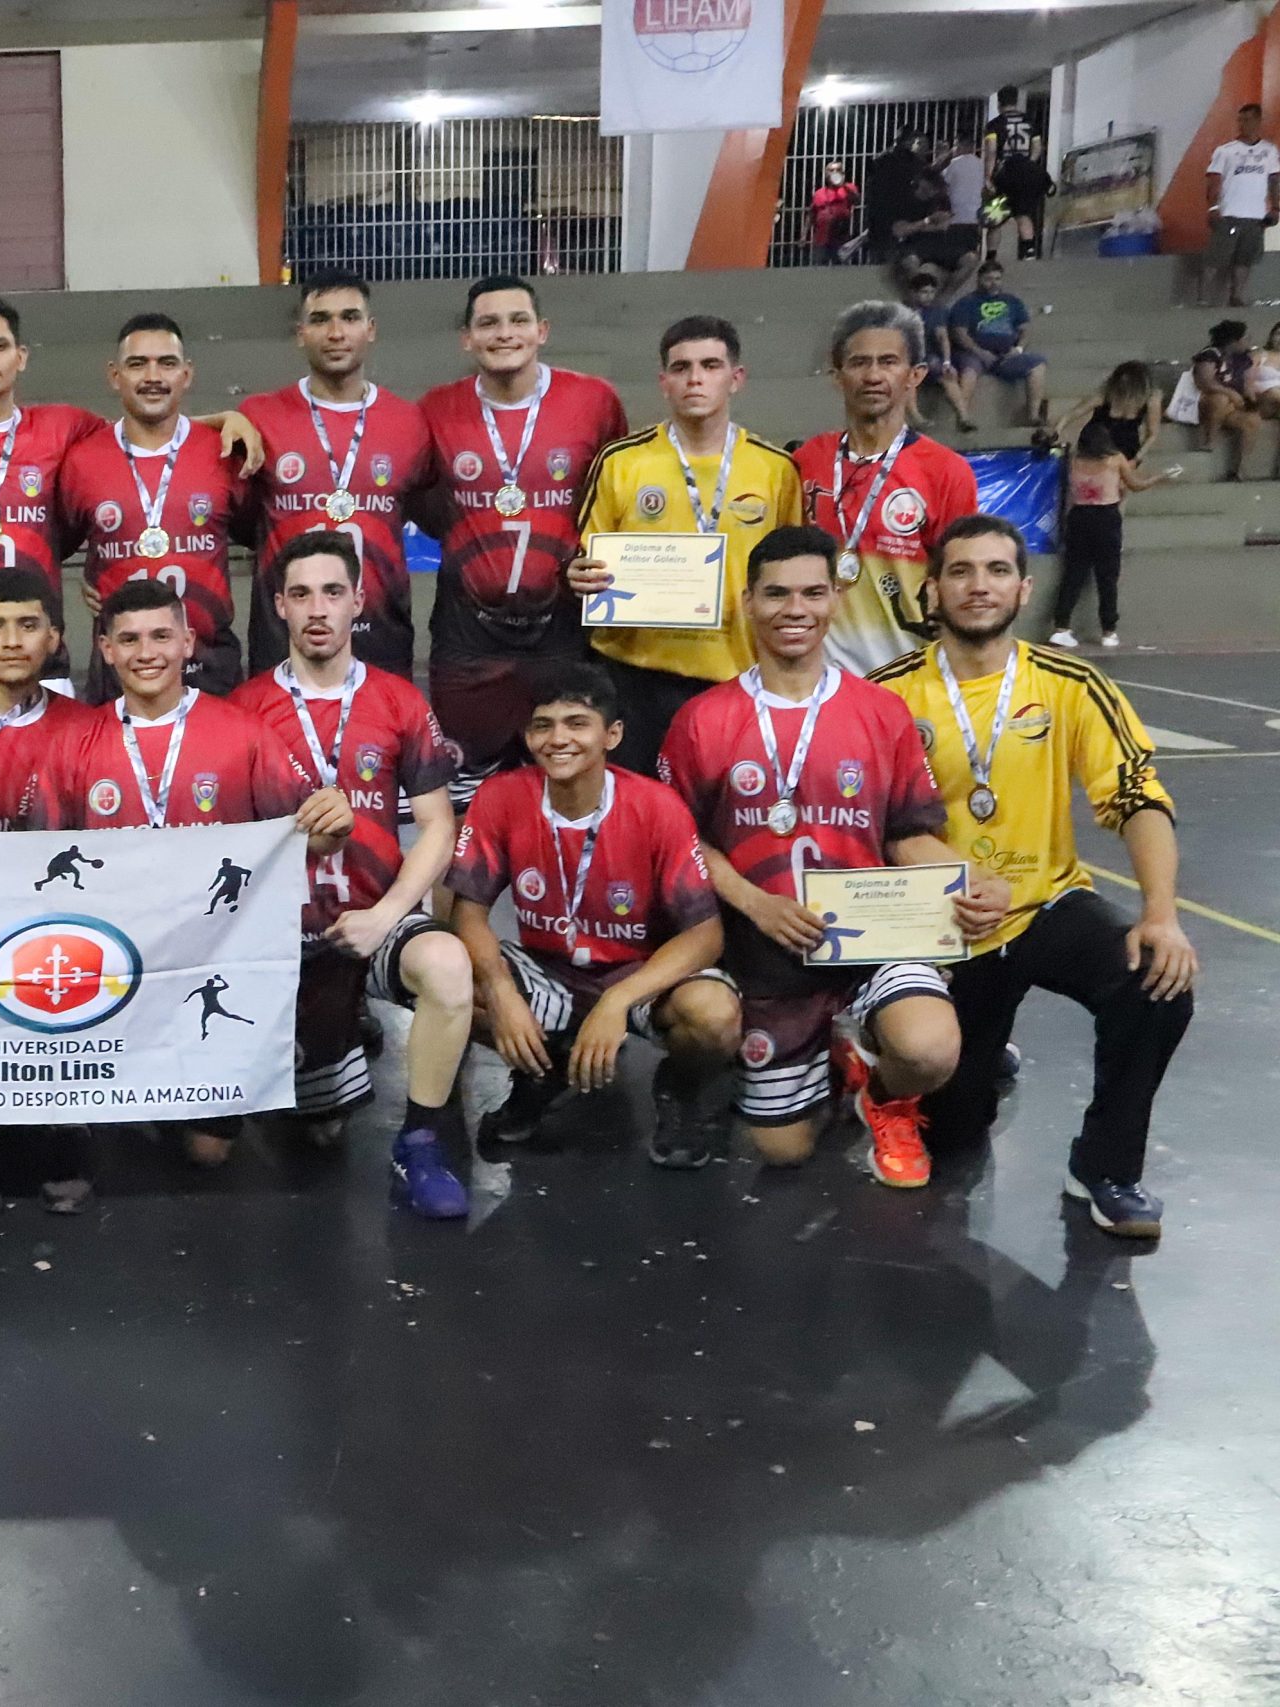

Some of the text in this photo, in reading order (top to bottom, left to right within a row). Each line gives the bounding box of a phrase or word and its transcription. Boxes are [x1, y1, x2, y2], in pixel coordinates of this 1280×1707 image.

[646, 0, 741, 27] LIHAM
[275, 493, 330, 511] NILTO
[454, 489, 573, 508] NILT LINS
[7, 505, 46, 522] LINS
[175, 534, 214, 553] LINS
[624, 543, 677, 555] Diploma de
[502, 520, 531, 594] 7
[620, 555, 687, 564] Melhor Goleiro
[351, 789, 384, 811] INS
[735, 806, 870, 829] NILN LINS
[455, 825, 473, 858] LINS
[844, 878, 909, 890] Diploma de
[852, 890, 907, 900] Artilheiro
[595, 920, 647, 940] LINS
[61, 1058, 116, 1082] Lins
[11, 1090, 105, 1108] DESPORTO
[110, 1088, 138, 1105] NA
[143, 1082, 245, 1103] AMAZÔNIA
